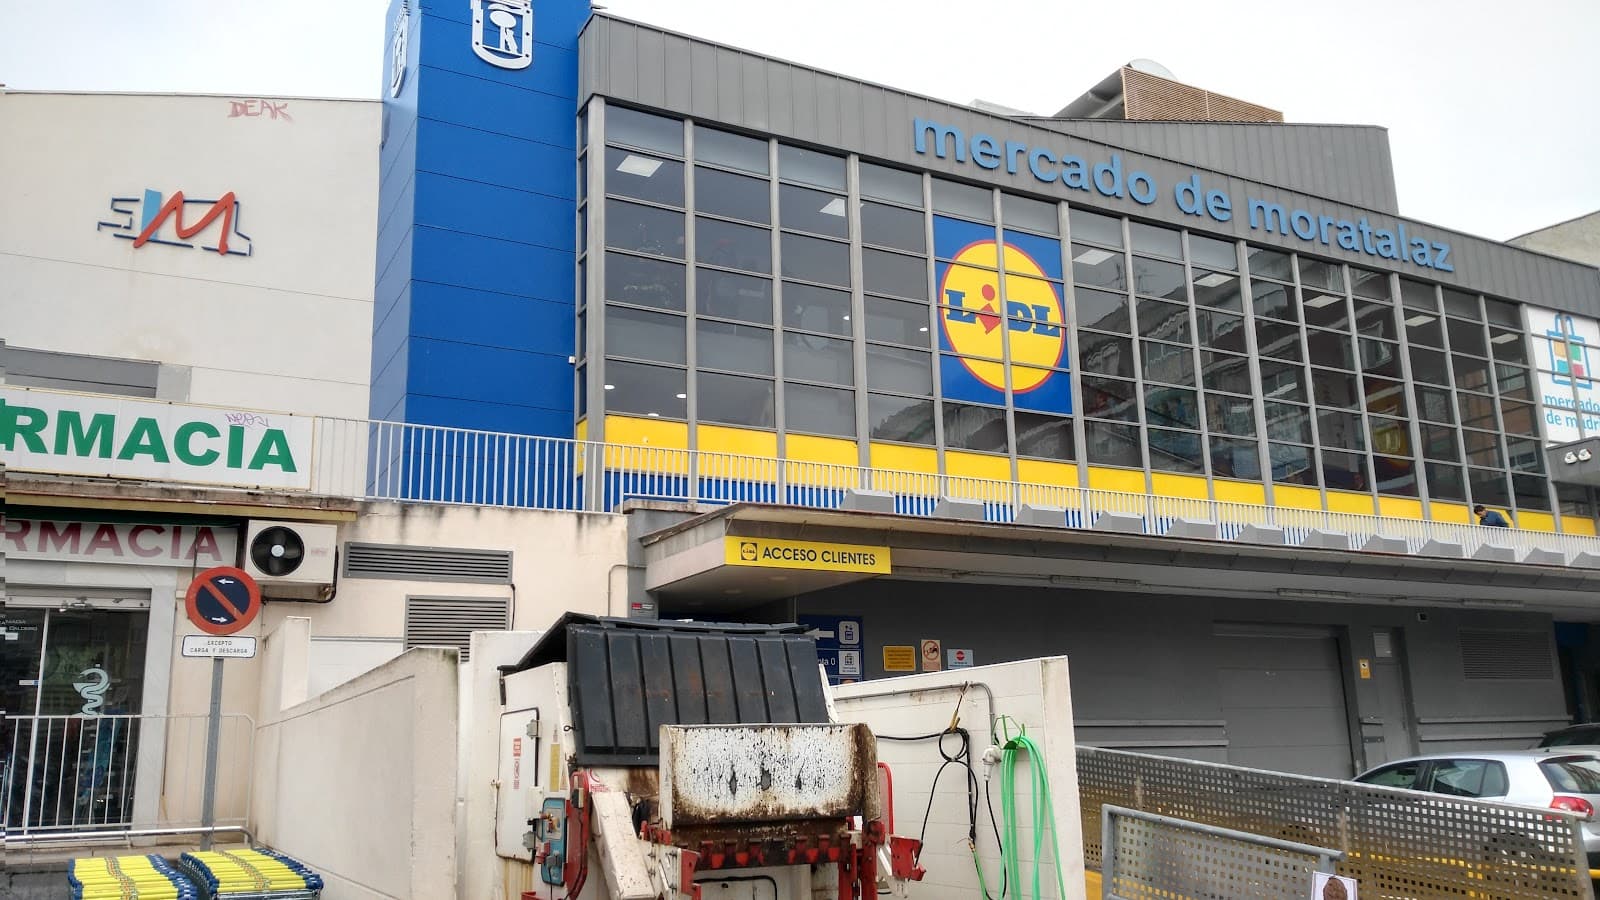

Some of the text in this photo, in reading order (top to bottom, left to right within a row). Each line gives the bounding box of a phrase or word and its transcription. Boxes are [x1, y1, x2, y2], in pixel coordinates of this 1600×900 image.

[914, 116, 1454, 273] mercado de moratalaz
[1546, 409, 1562, 426] de
[762, 546, 876, 566] ACCESO CLIENTES
